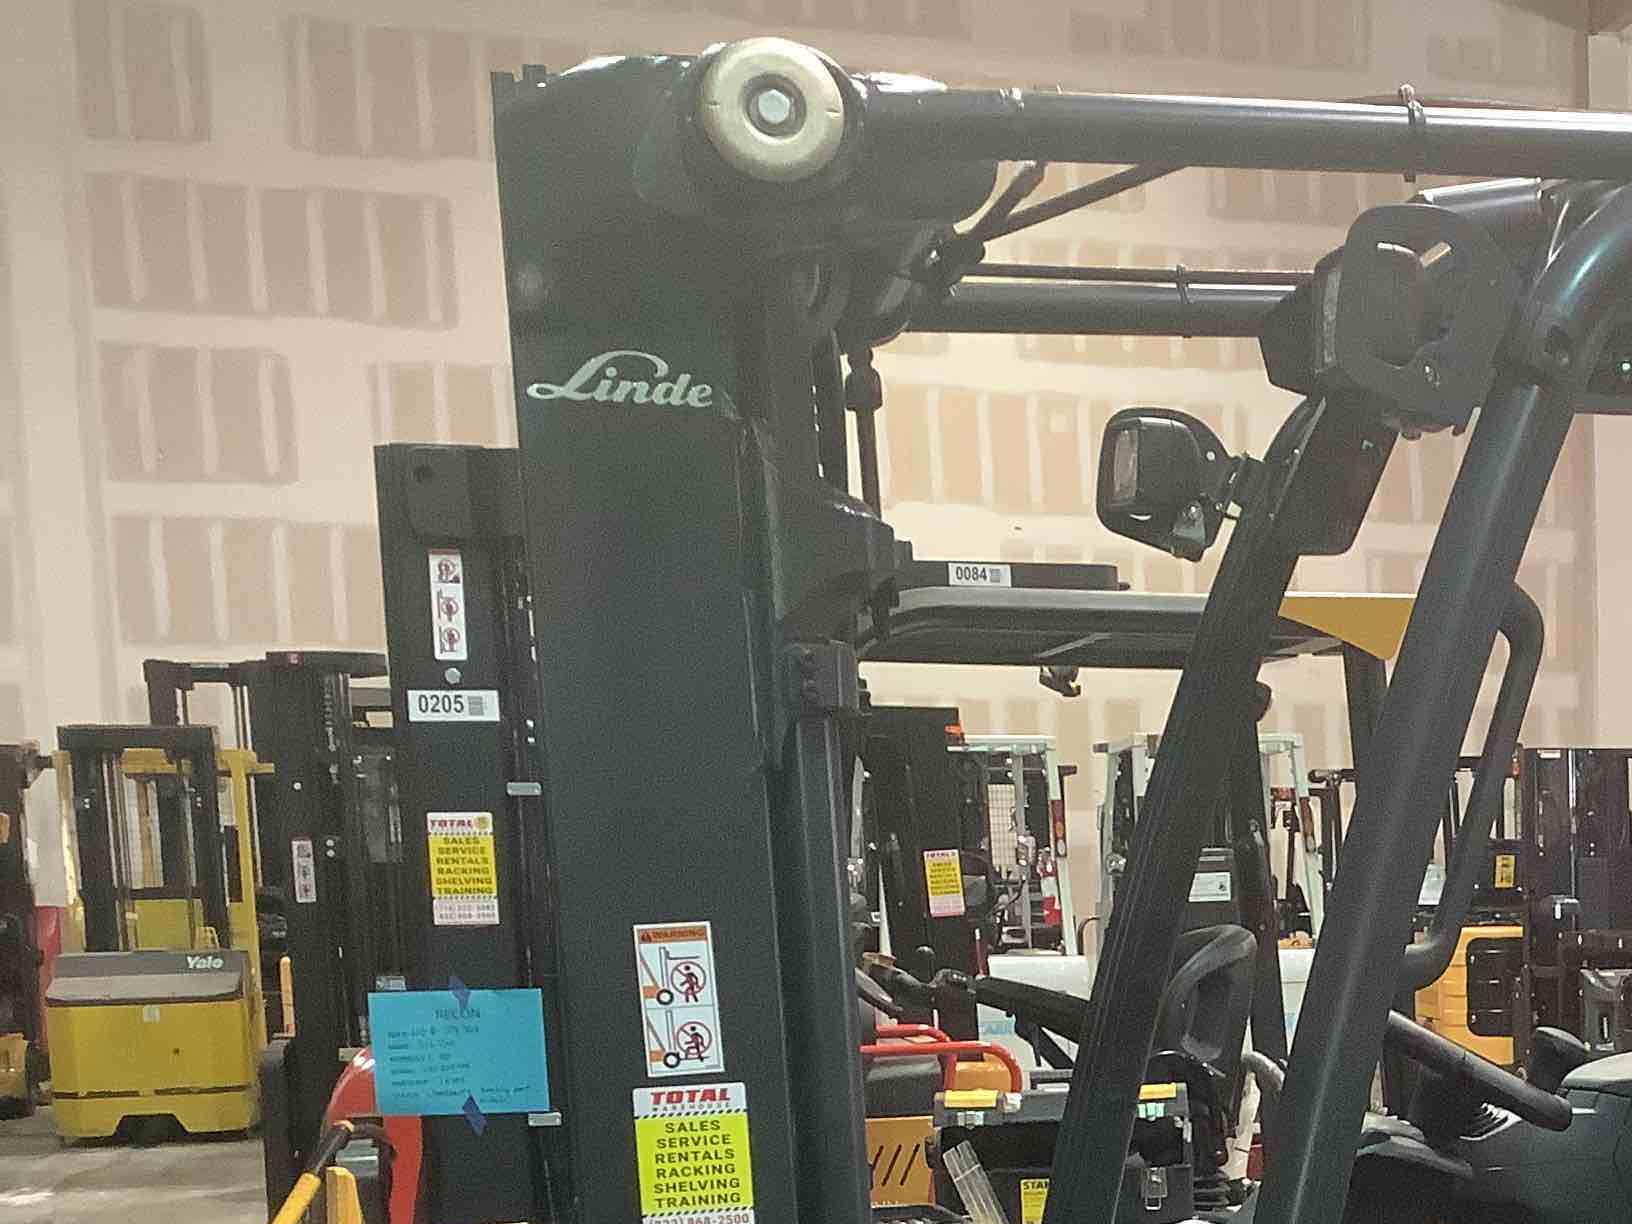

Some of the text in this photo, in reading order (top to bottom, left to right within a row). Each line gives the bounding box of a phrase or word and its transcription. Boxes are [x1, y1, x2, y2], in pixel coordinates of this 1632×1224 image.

[526, 350, 713, 408] Linde
[956, 566, 988, 580] 0084
[418, 695, 465, 714] 0205
[430, 819, 473, 828] TOTAL
[443, 836, 480, 845] SALES
[437, 846, 486, 855] SERVICE
[436, 857, 489, 865] RENTALS
[437, 867, 490, 875] RACKING
[436, 877, 493, 885] SHELVING
[437, 887, 493, 895] TRAINING
[186, 956, 224, 970] Yale
[650, 1088, 731, 1105] TOTAL
[665, 1120, 721, 1133] SALES
[657, 1134, 732, 1149] SERVICE
[655, 1148, 735, 1164] RENTALS
[656, 1163, 736, 1179] RACKING
[654, 1178, 740, 1194] SHELVING
[654, 1193, 741, 1208] TRAINING
